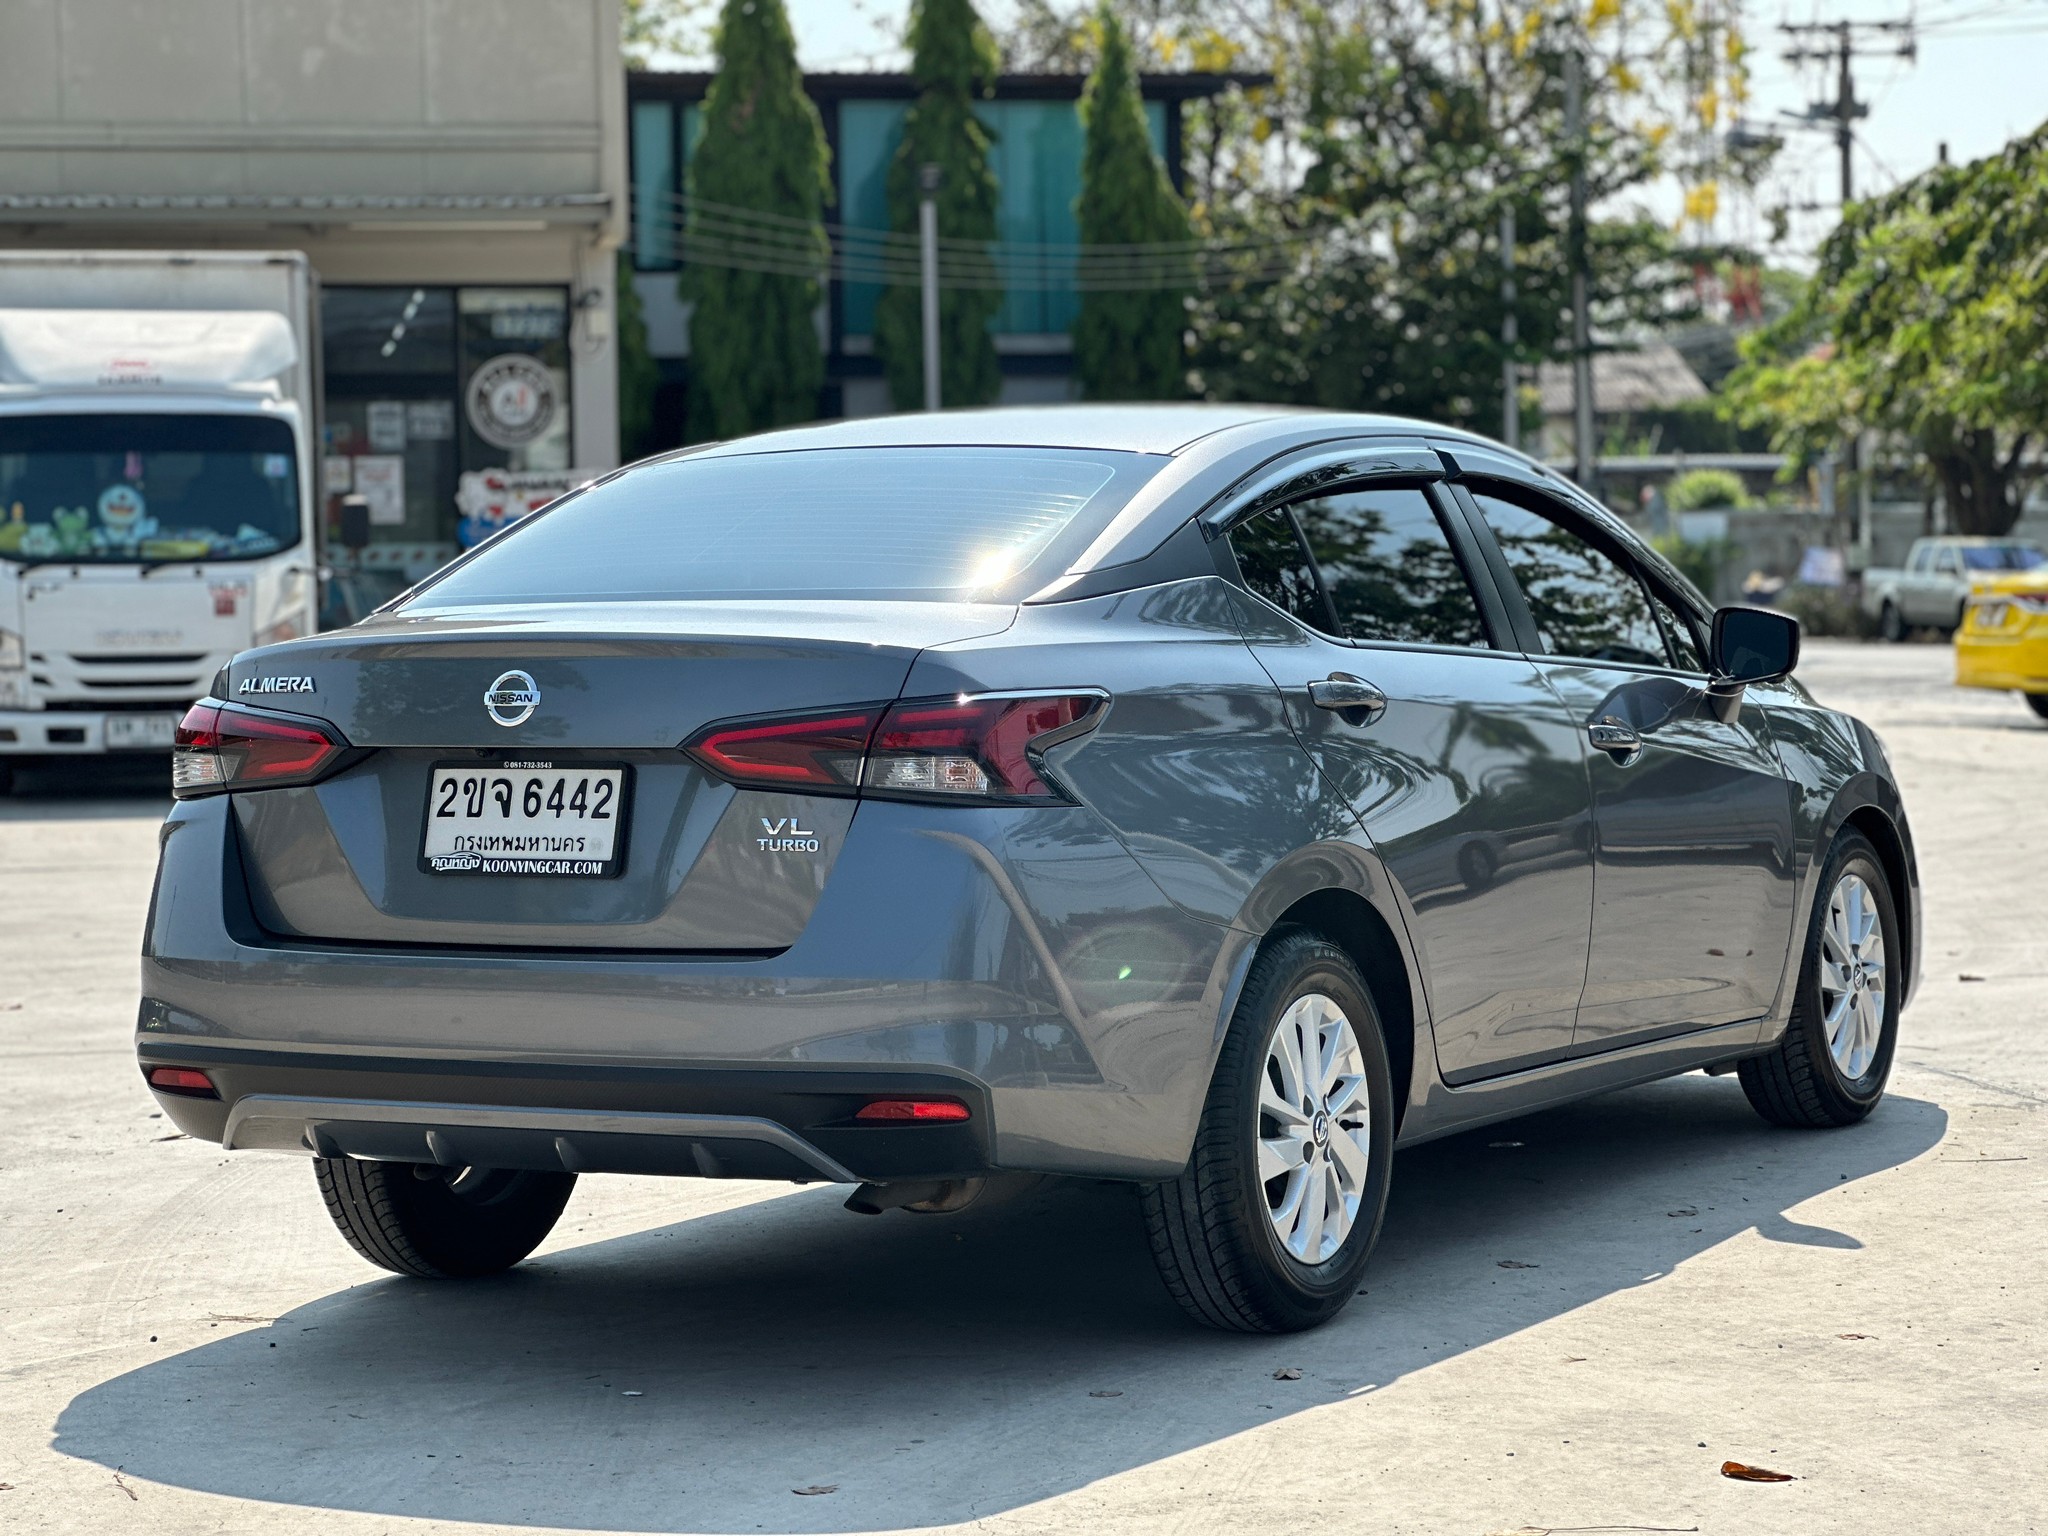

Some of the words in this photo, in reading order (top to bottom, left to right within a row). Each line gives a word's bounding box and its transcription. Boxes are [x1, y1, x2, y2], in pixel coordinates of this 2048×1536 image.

[238, 676, 316, 695] ALMERA
[488, 693, 533, 703] NISSAN
[437, 777, 513, 818] 2ขจ
[523, 778, 613, 819] 6442
[760, 817, 815, 836] VL
[756, 838, 820, 853] TURBO
[482, 859, 602, 875] KOONYINGCAR.COM
